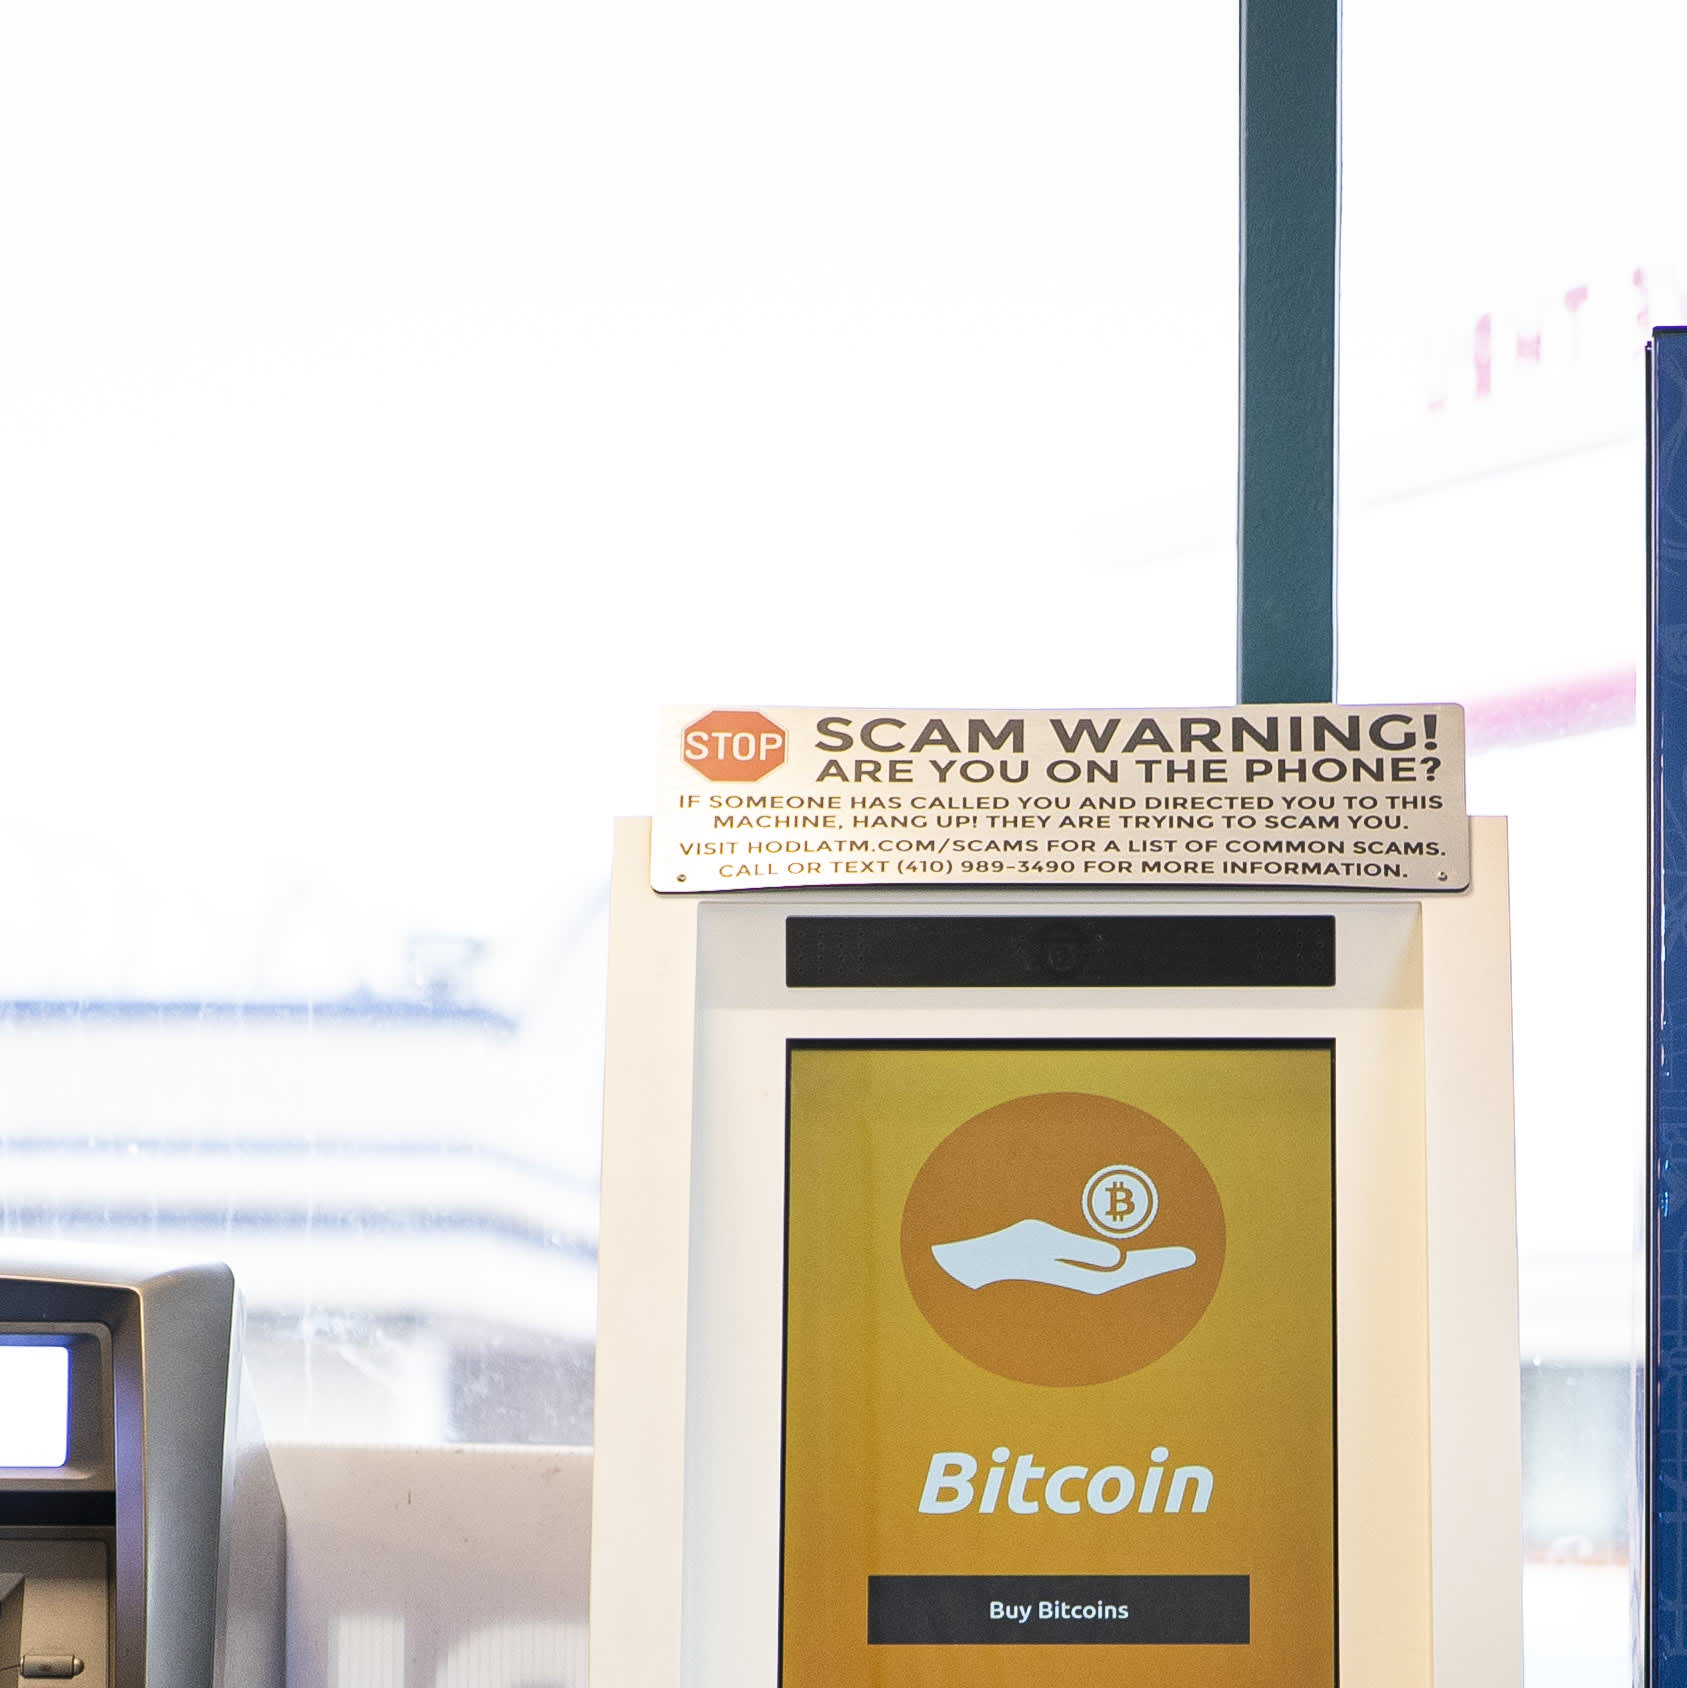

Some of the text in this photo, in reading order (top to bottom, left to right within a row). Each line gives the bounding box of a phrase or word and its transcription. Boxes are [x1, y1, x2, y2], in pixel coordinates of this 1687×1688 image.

[815, 714, 1437, 754] SCAM WARNING!
[685, 731, 783, 761] STOP
[816, 757, 1441, 783] ARE YOU ON THE PHONE?
[680, 795, 1443, 810] IF SOMEONE HAS CALLED YOU AND DIRECTED YOU TO THIS
[714, 815, 1408, 830] MACHINE, HANG UP! THEY ARE TRYING TO SCAM YOU.
[680, 839, 1446, 856] VISIT HODLATM.COM/SCAMS FOR A LIST OF COMMON SCAMS.
[719, 860, 1408, 878] CALL OR TEXT (410) 989-3490 FOR MORE INFORMATION.
[918, 1446, 1214, 1514] Bitcoin
[989, 1600, 1129, 1623] Buy Bitcoins
